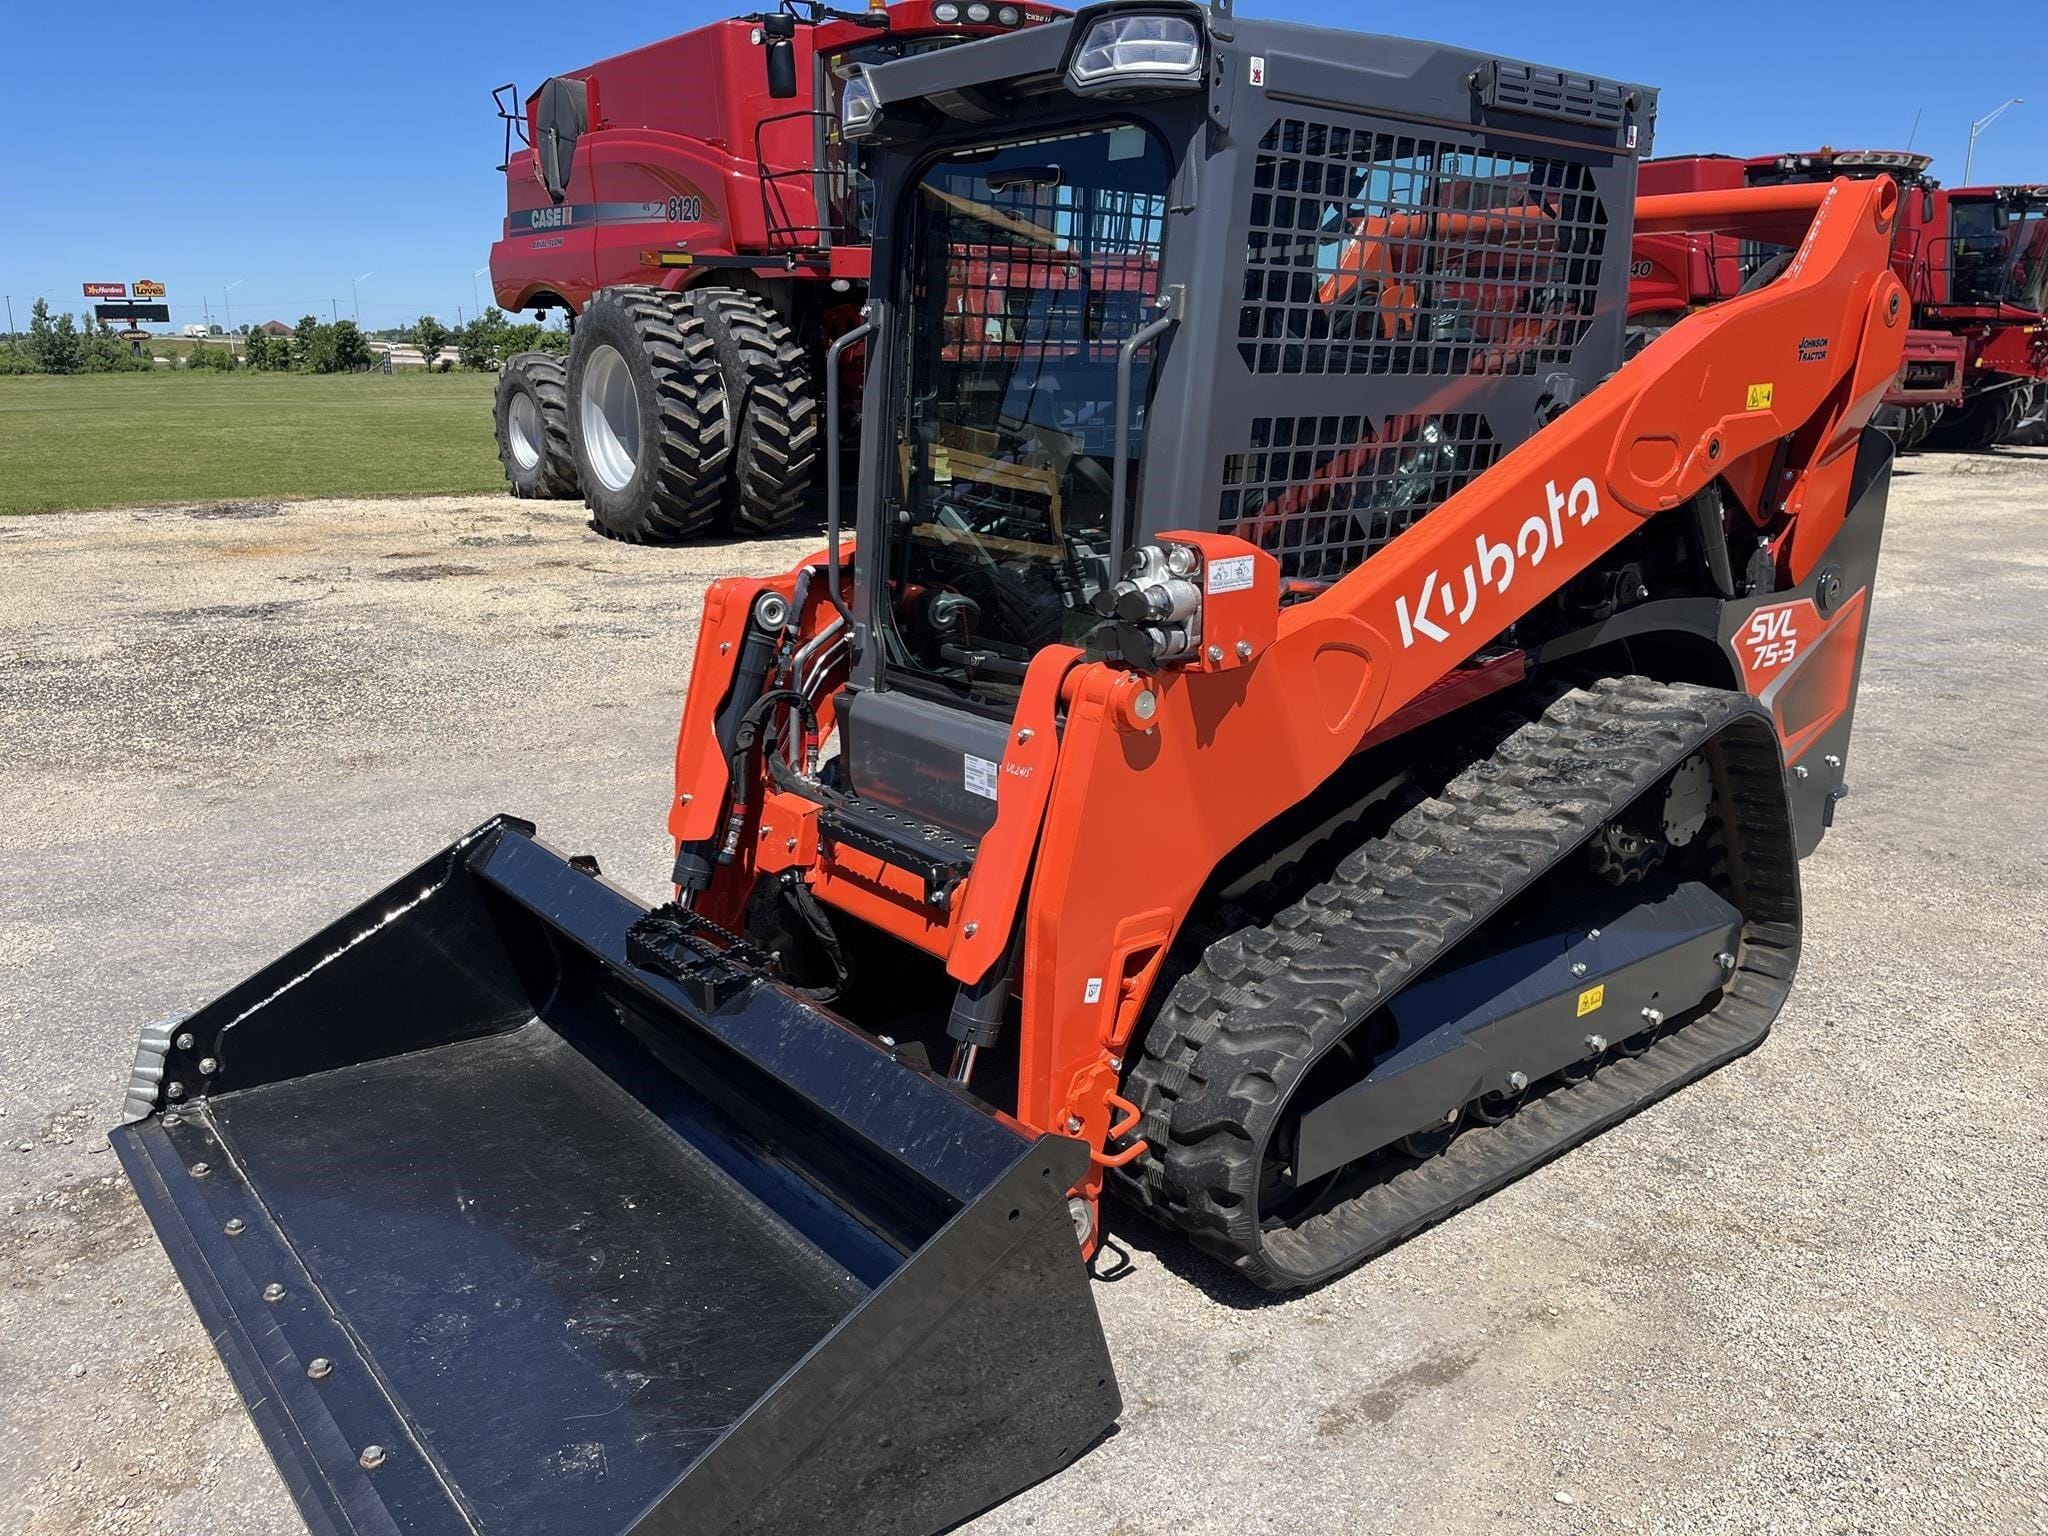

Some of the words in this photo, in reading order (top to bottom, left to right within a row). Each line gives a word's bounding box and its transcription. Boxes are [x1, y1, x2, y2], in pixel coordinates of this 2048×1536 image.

[531, 207, 562, 229] CASE
[667, 196, 701, 223] 8120
[136, 286, 164, 295] Love's
[1798, 337, 1829, 349] JOHNSON
[1798, 350, 1827, 361] TRACTOR
[1394, 477, 1600, 649] Kubota
[1746, 609, 1797, 645] SVL
[1752, 639, 1797, 671] 75-3
